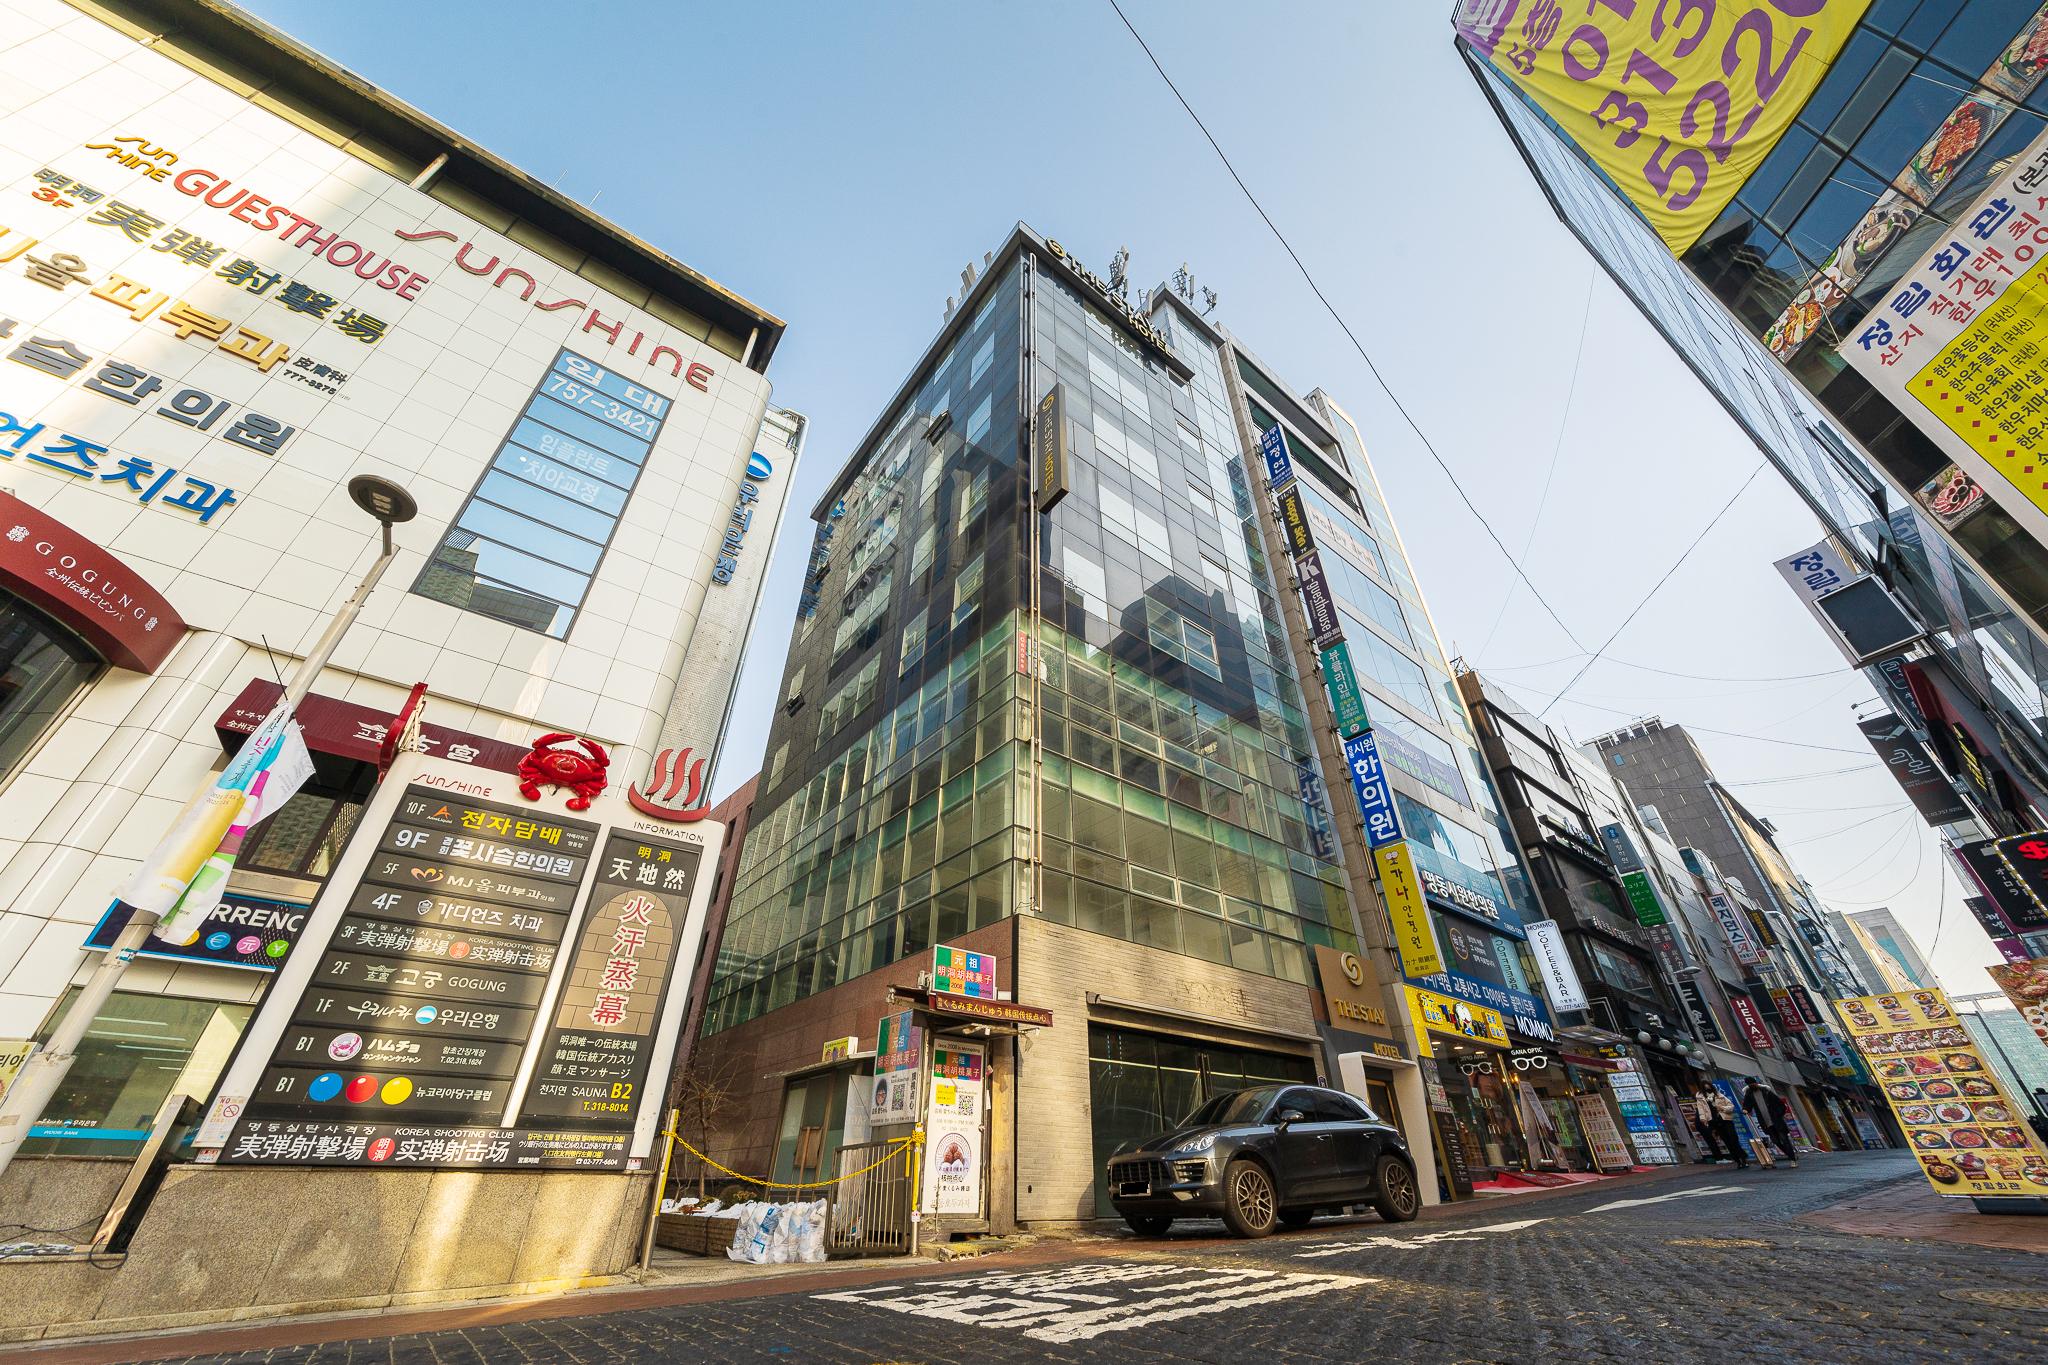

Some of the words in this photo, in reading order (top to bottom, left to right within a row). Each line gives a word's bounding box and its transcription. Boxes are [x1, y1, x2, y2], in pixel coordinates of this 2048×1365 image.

[1642, 0, 1828, 212] 522
[85, 142, 174, 184] SHINE
[115, 136, 179, 167] SUN
[31, 187, 75, 209] 3F
[32, 167, 106, 205] 明洞
[173, 167, 430, 301] GUESTHOUSE
[1857, 197, 2017, 352] 정림회관
[24, 252, 93, 292] 올
[89, 273, 291, 374] 피부과
[394, 229, 715, 393] SUNSHINE
[1880, 322, 1925, 367] 산지
[1927, 246, 2006, 317] 직거래
[1128, 312, 1174, 360] HOTEL
[1932, 328, 1991, 379] 한우꽃등심
[1983, 304, 2018, 333] (국내산)
[1948, 340, 2009, 393] 한우주물럭
[2001, 317, 2036, 346] (국내산)
[0, 318, 297, 456] 슴한의원
[1964, 363, 2014, 406] 한우육회
[2008, 341, 2041, 370] (국내산)
[549, 373, 657, 438] 757-3421
[1980, 368, 2046, 420] 한우갈비살
[539, 433, 612, 477] 임플란트
[523, 458, 602, 505] 치아교정
[1285, 495, 1301, 527] Happy
[1293, 525, 1307, 548] Skin
[35, 541, 147, 621] GOGUNG
[1354, 737, 1375, 755] 시원
[412, 773, 493, 798] SUNSHINE
[1353, 756, 1397, 841] 한의원
[394, 829, 430, 849] 9F
[460, 808, 563, 846] 전자담배
[633, 820, 705, 844] INFORMATION
[382, 862, 400, 875] 5F
[450, 835, 575, 877] 꽃사슴한의원
[636, 845, 672, 863] 明洞
[446, 875, 475, 889] MJ
[474, 878, 495, 894] 올
[608, 857, 687, 891] 天地然
[371, 892, 402, 910] 4F
[1390, 867, 1423, 950] 가나안경원
[1422, 869, 1501, 921] 명동시원한의원
[209, 902, 305, 934] RRENC
[340, 925, 358, 939] 3F
[437, 901, 504, 927] 가디언즈
[508, 912, 545, 934] 치과
[1526, 921, 1554, 932] MOMMO
[467, 936, 496, 947] KOREA
[496, 940, 535, 952] SHOOTING
[535, 945, 556, 955] CLUB
[590, 894, 654, 1028] 火汗蒸幕
[954, 954, 979, 969] 元祖
[331, 960, 351, 975] 2F
[394, 967, 444, 989] 고궁
[1537, 930, 1569, 997] COFFEE&BAR
[448, 976, 507, 993] GOGUNG
[1452, 975, 1482, 999] 교통사고
[315, 998, 334, 1013] 1F
[437, 1009, 501, 1030] 우리은행
[1736, 999, 1761, 1035] HERA
[295, 1036, 315, 1052] B1
[1514, 1013, 1556, 1043] MOMMO
[1372, 1041, 1402, 1060] HOTEL
[1510, 1047, 1527, 1056] GANA
[1526, 1046, 1543, 1055] OPTIC
[274, 1076, 296, 1093] B1
[415, 1086, 493, 1102] 뉴코리아당구클럽
[571, 1085, 609, 1098] SAUNA
[610, 1081, 634, 1100] B2
[394, 1126, 432, 1138] KOREA
[434, 1128, 487, 1139] SHOOTING
[488, 1131, 515, 1140] CLUB
